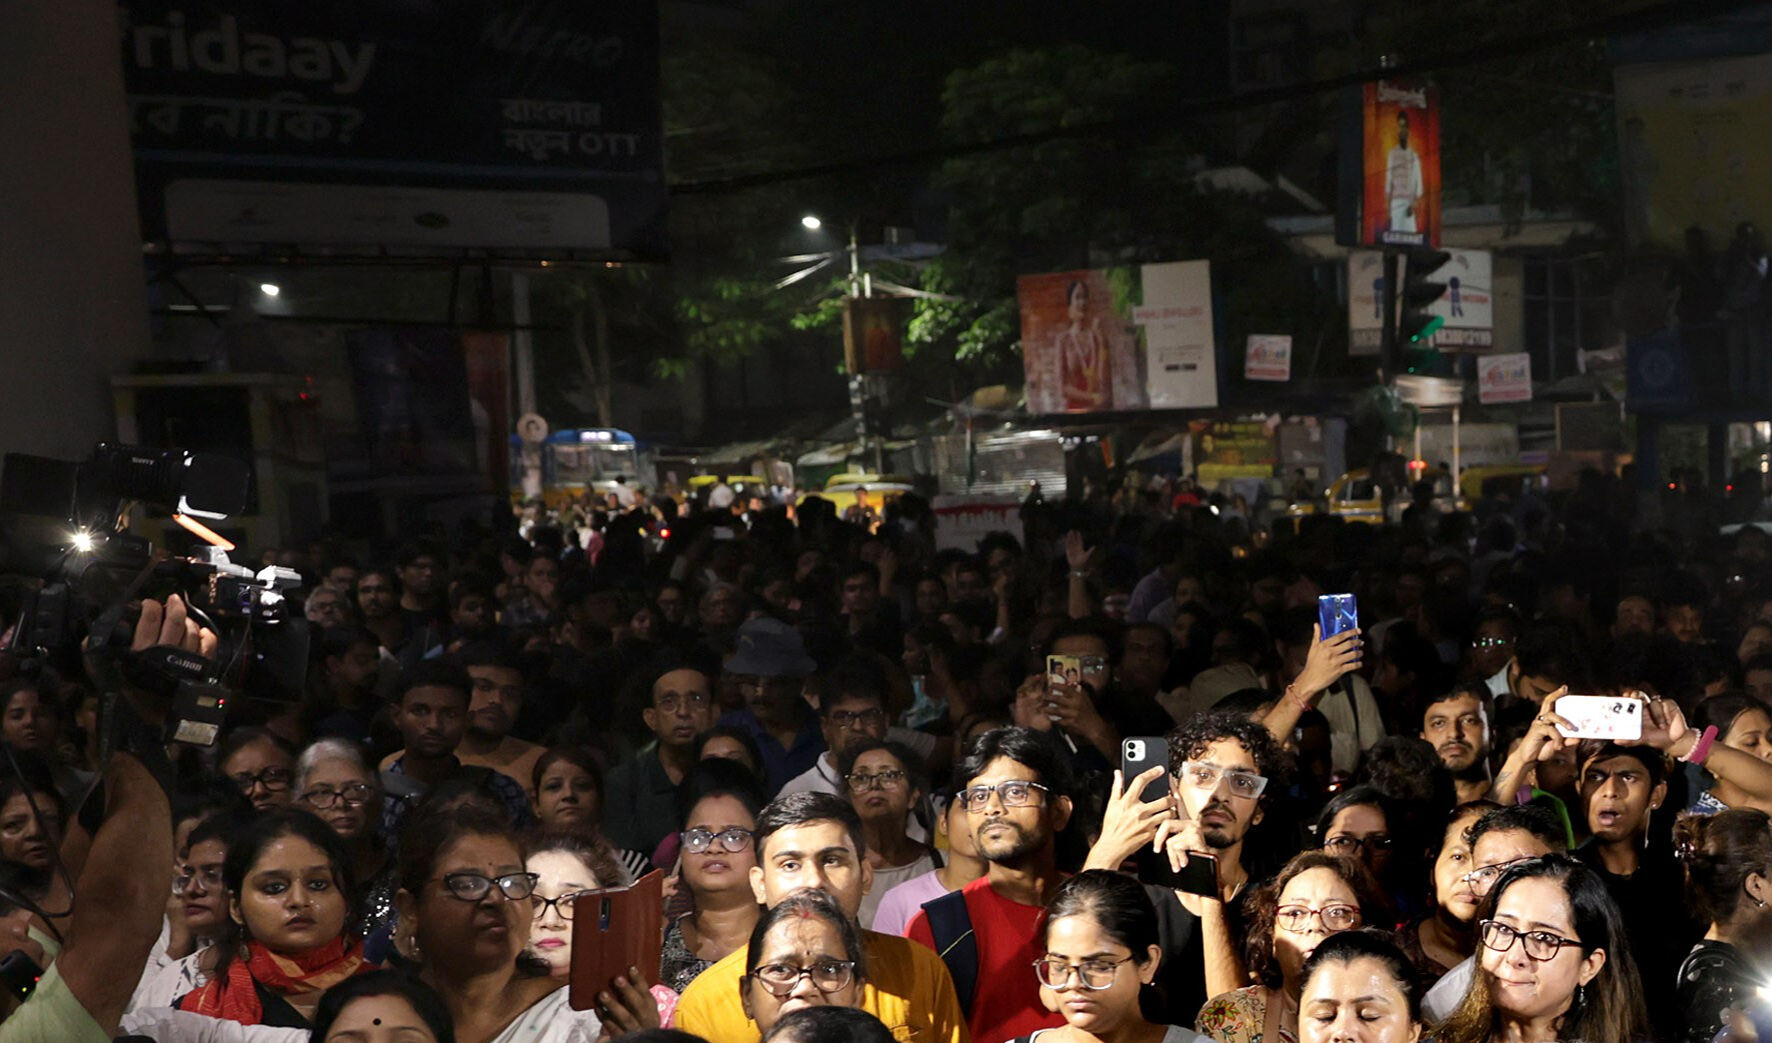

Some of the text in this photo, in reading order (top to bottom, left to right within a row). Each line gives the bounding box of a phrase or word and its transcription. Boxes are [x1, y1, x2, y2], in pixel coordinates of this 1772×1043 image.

[498, 98, 601, 126] বাংলার
[501, 129, 640, 161] নতুন OTT
[166, 653, 204, 673] Canon
